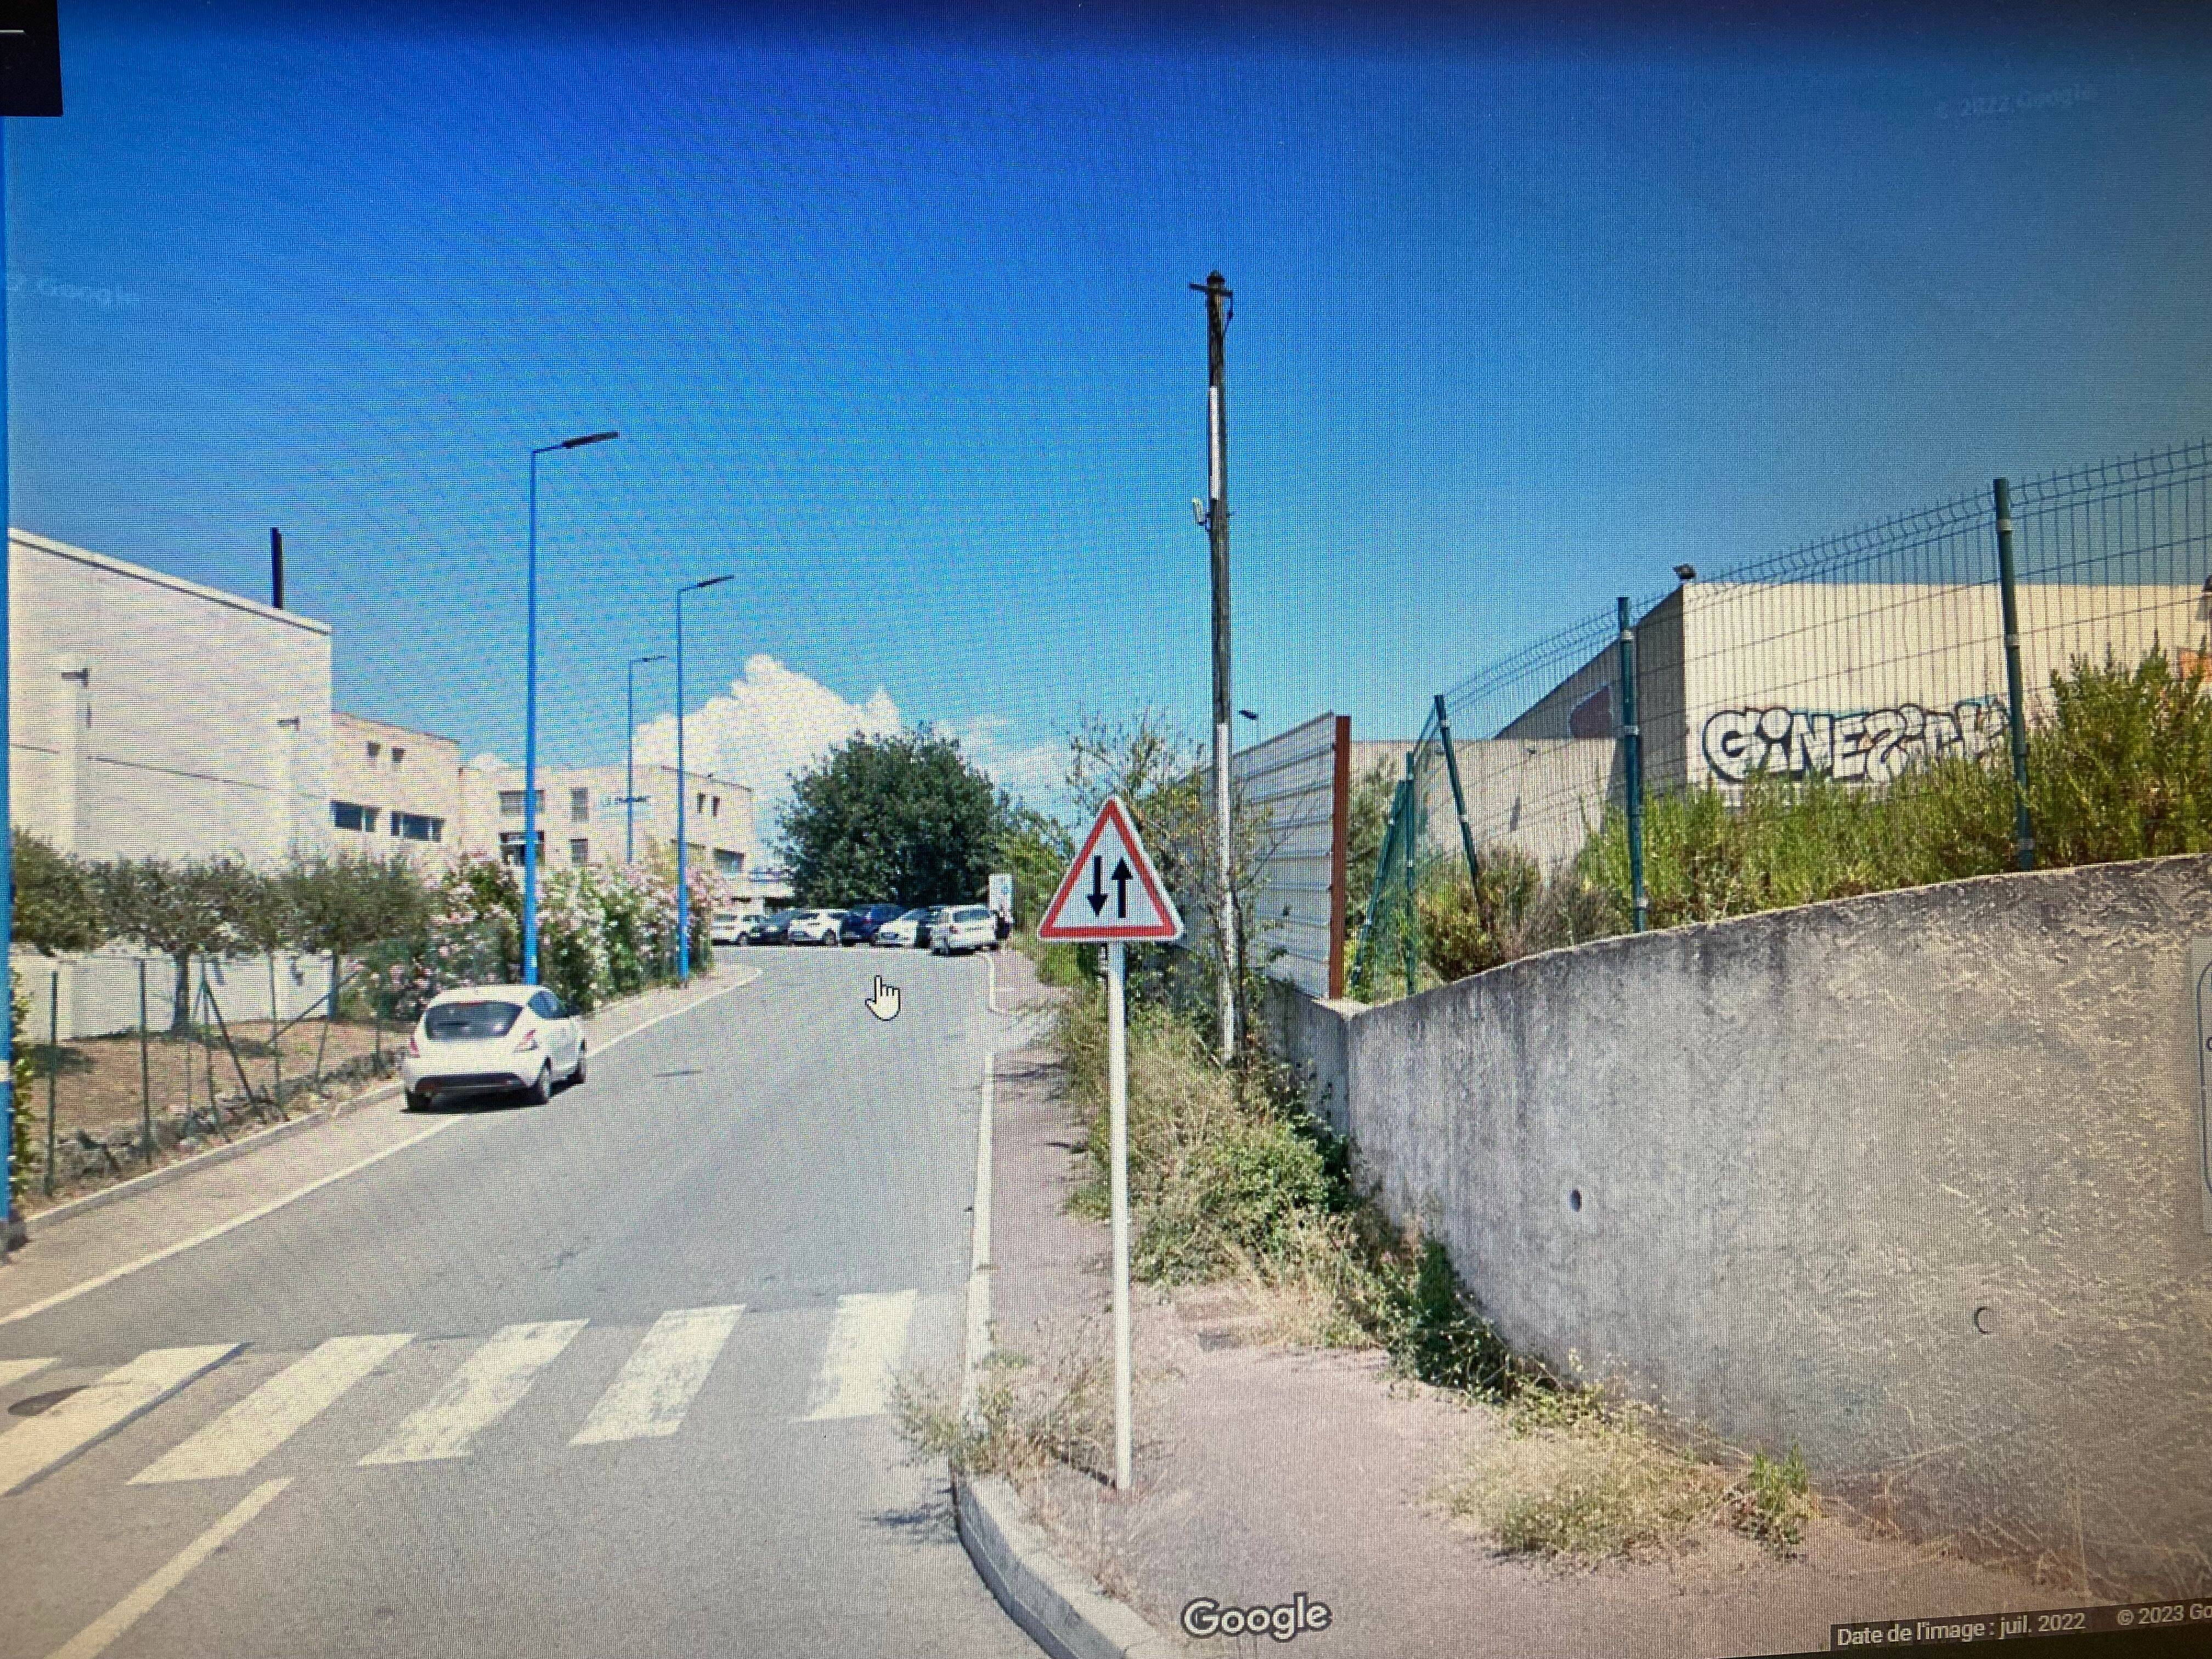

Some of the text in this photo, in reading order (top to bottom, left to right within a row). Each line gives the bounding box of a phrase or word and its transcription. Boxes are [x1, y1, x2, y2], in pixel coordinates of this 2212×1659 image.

[1181, 1591, 1332, 1643] Google
[1838, 1627, 1883, 1646] Date
[1888, 1623, 1912, 1642] de
[1997, 1615, 2032, 1640] juil.
[2038, 1612, 2086, 1632] 2022
[2137, 1605, 2185, 1624] 2023
